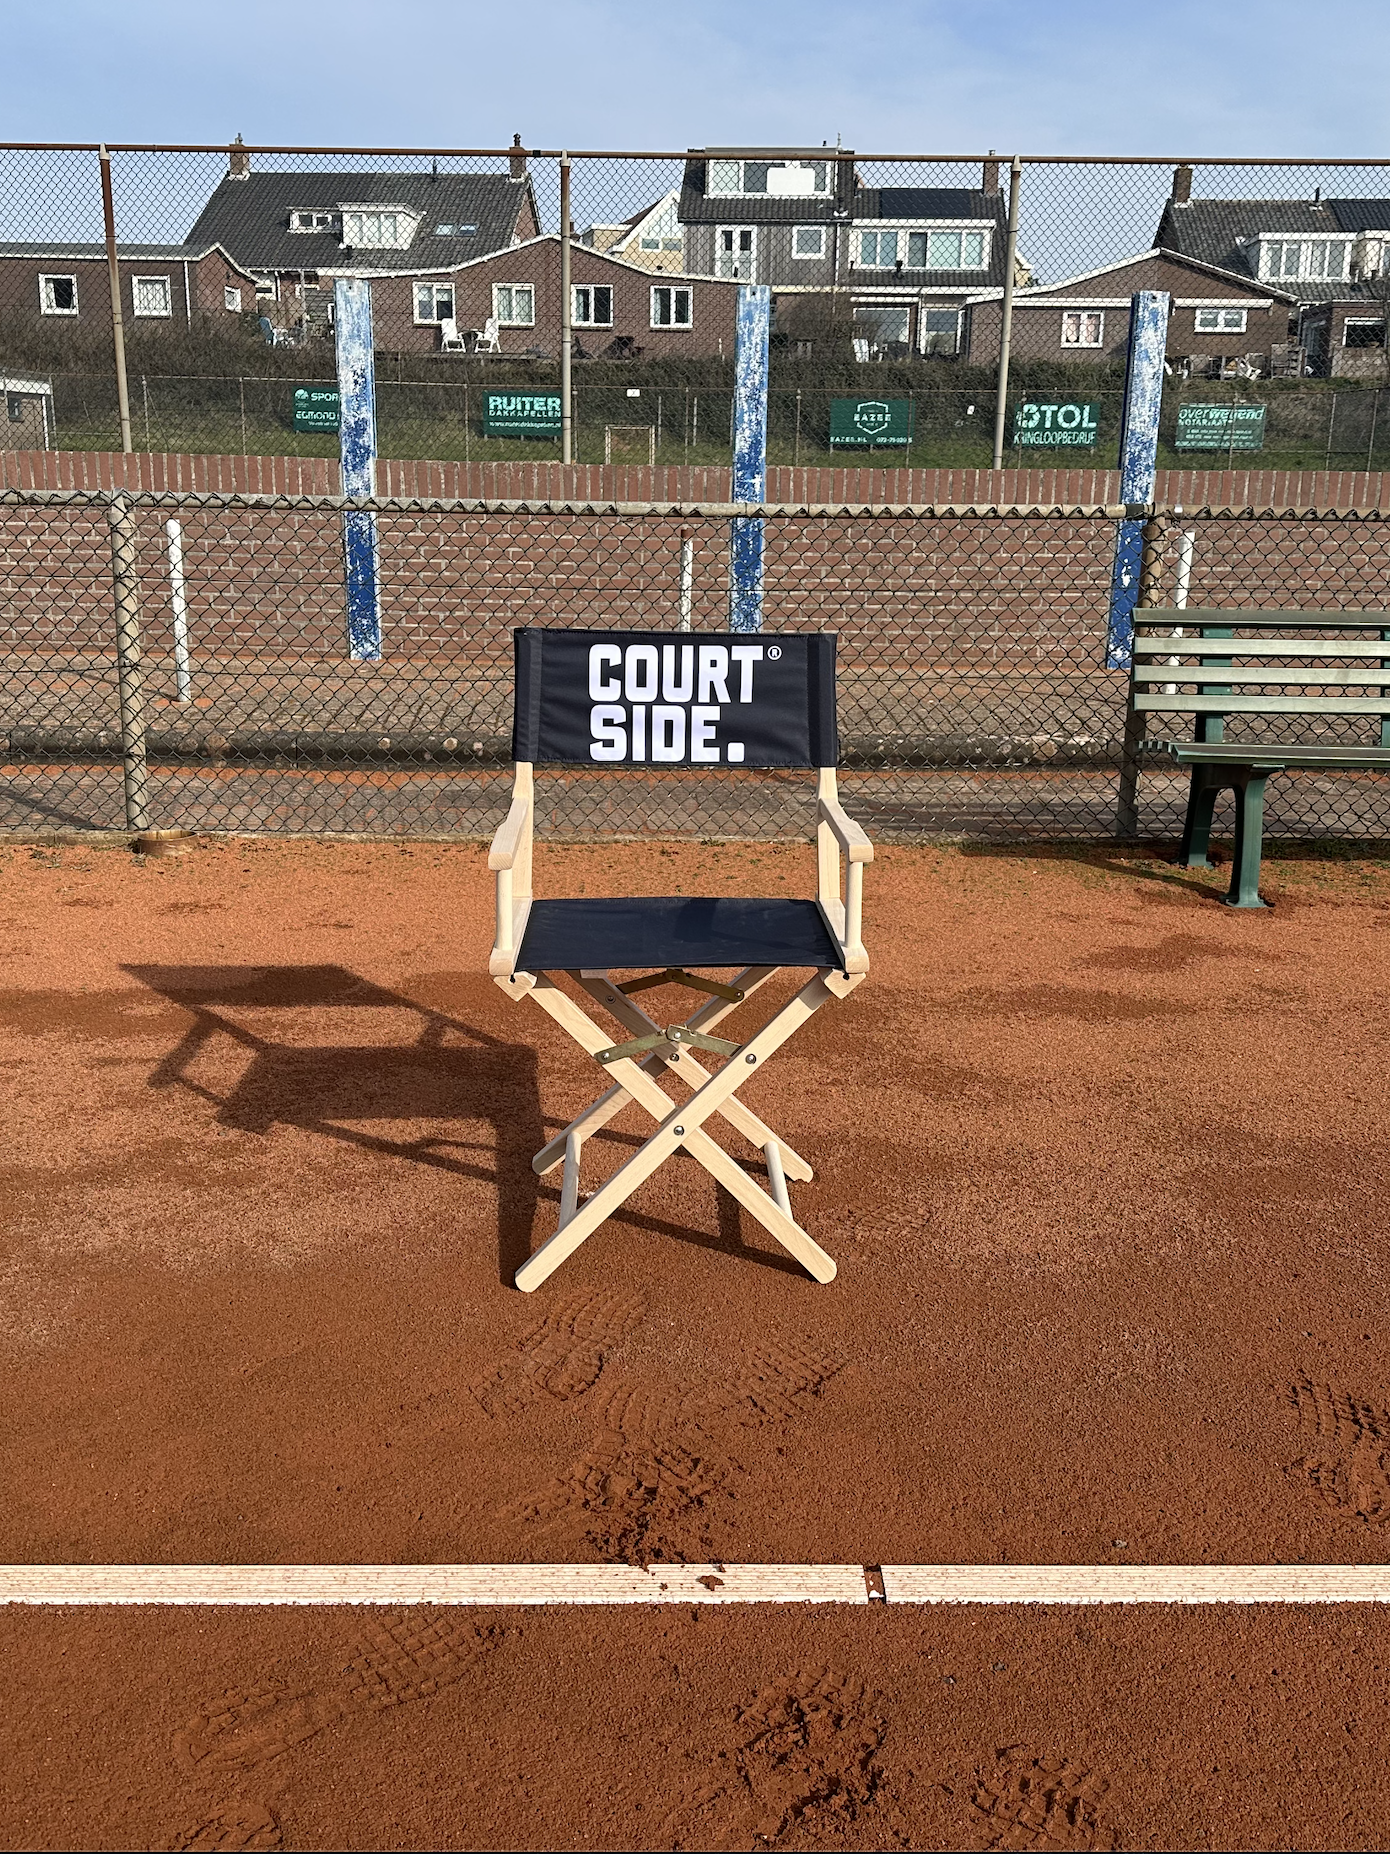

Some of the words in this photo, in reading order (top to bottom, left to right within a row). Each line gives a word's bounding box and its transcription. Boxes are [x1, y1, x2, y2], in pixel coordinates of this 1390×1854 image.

[488, 396, 561, 411] RUITER
[295, 410, 336, 420] EGMOND
[488, 410, 562, 418] DAKKAPELLEN
[589, 704, 745, 763] SIDE.
